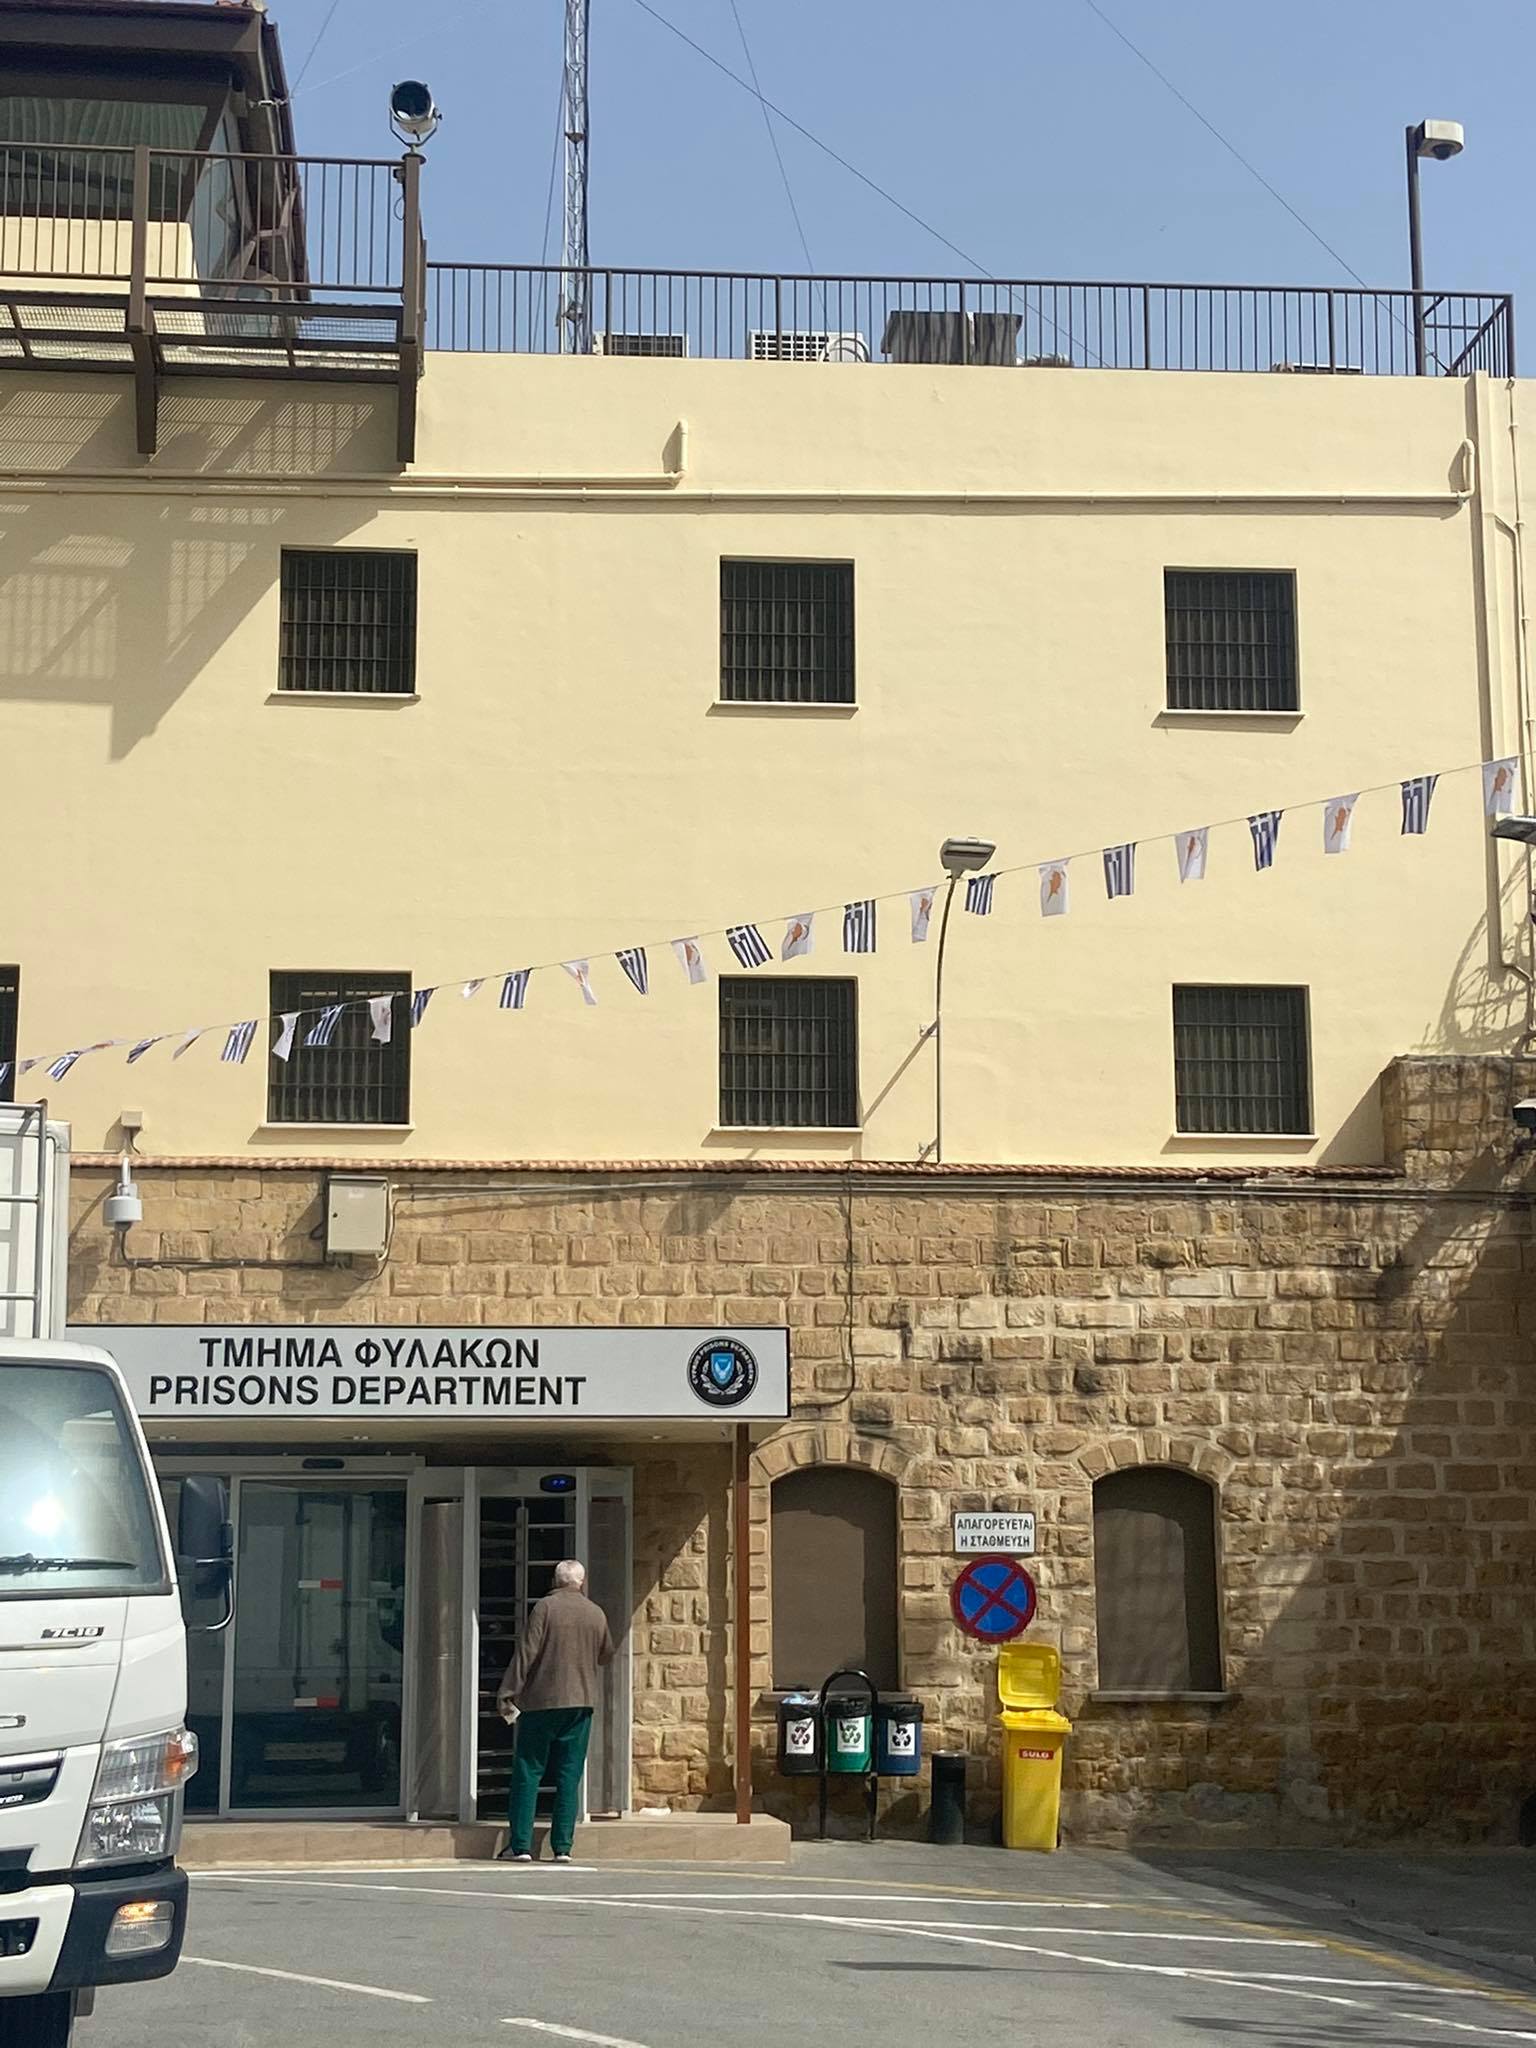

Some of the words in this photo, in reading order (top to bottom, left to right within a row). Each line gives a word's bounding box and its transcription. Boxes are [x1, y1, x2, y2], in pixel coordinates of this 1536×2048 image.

[200, 1338, 343, 1368] ΤΜΗΜΑ
[355, 1338, 540, 1368] ΦΥΛΑΚΩΝ
[149, 1375, 320, 1405] PRISONS
[332, 1376, 587, 1406] DEPARTMENT
[957, 1518, 1033, 1530] ΑΠΑΓΟΡΕΥΕΤΑΙ
[960, 1536, 968, 1547] Η
[970, 1535, 1030, 1547] ΣΤΑΘΜΕΥΣΗ
